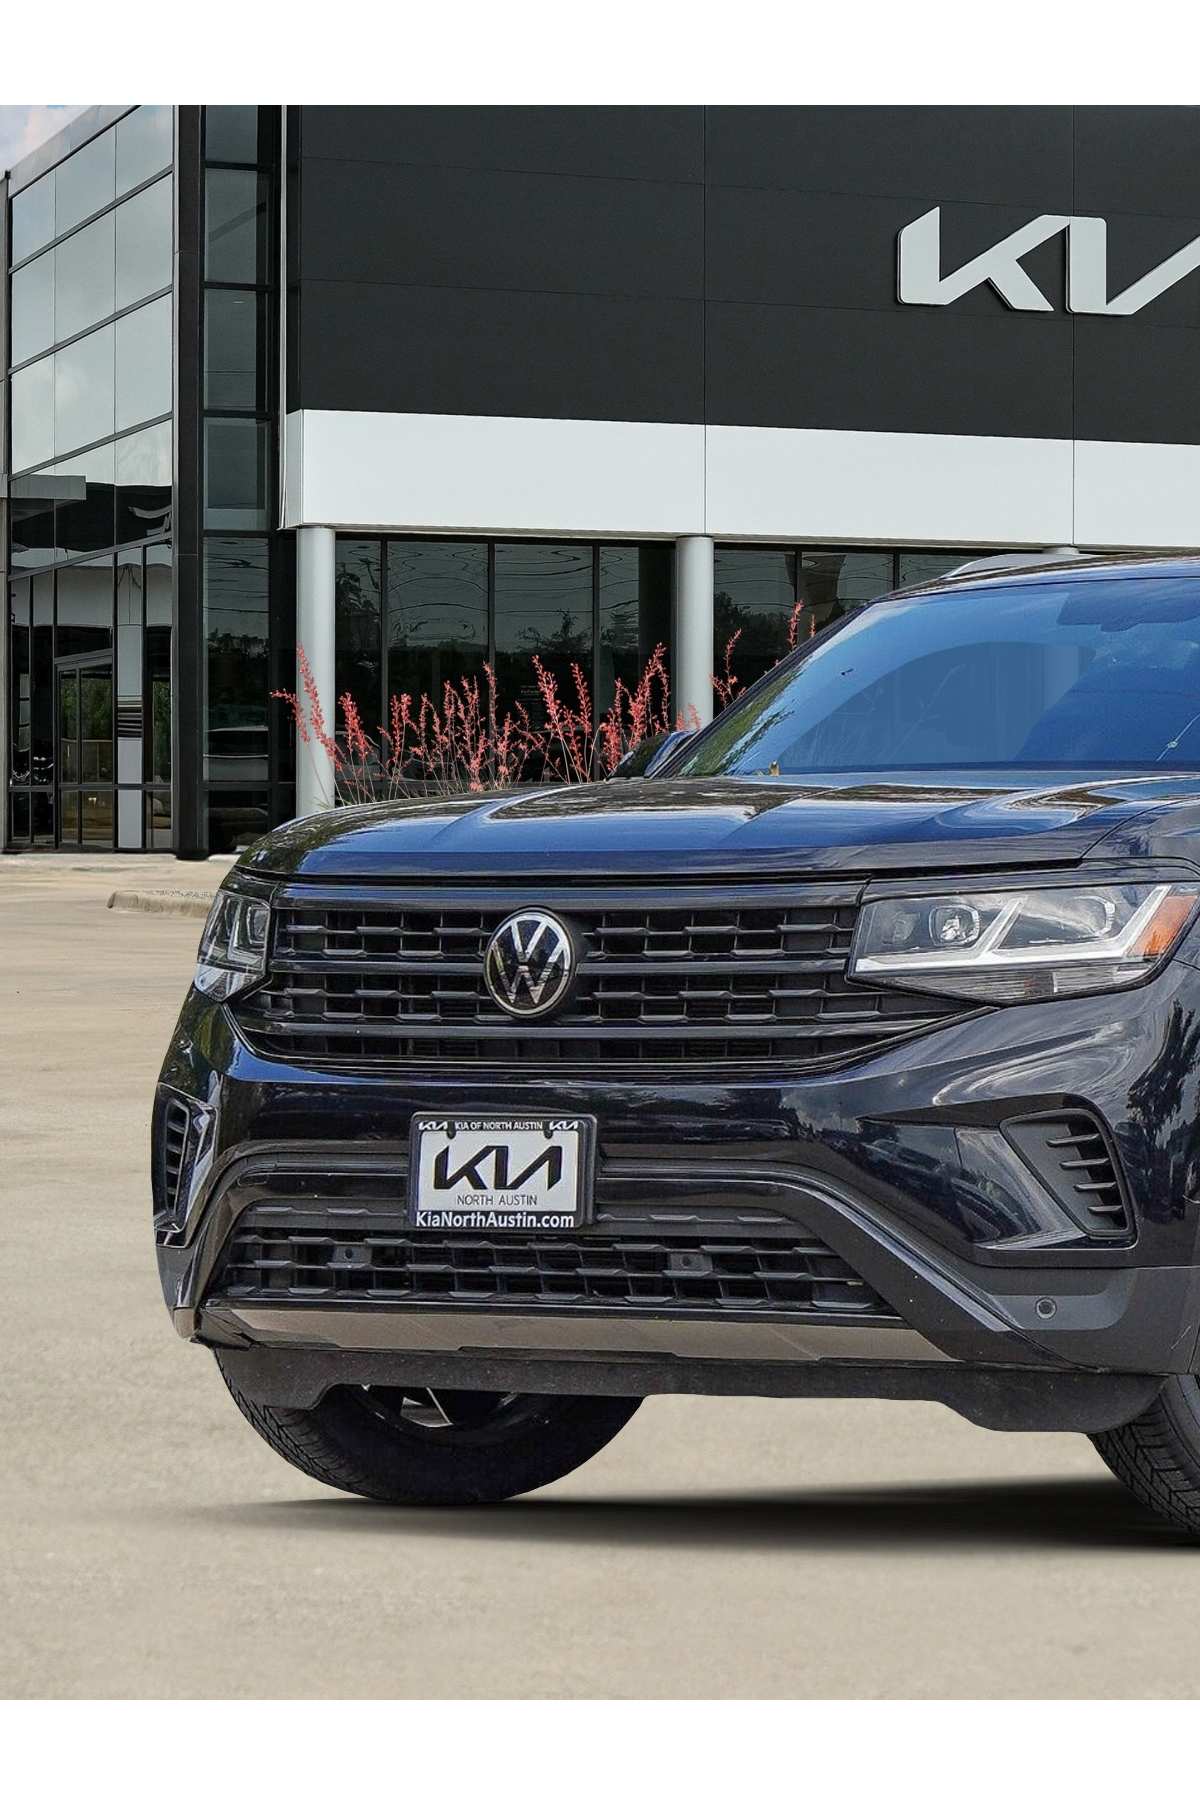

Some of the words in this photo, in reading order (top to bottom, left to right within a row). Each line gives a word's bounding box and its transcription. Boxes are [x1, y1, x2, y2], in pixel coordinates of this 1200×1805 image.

[418, 1121, 448, 1131] KIA
[454, 1121, 469, 1131] KIA
[470, 1121, 481, 1130] OF
[483, 1121, 512, 1130] NORTH
[513, 1121, 543, 1130] AUSTIN
[549, 1120, 579, 1131] KIA
[433, 1145, 563, 1191] KIA
[457, 1194, 494, 1206] NORTH
[498, 1194, 538, 1206] AUSTIN
[416, 1211, 575, 1228] KiaNorthAustin.com
